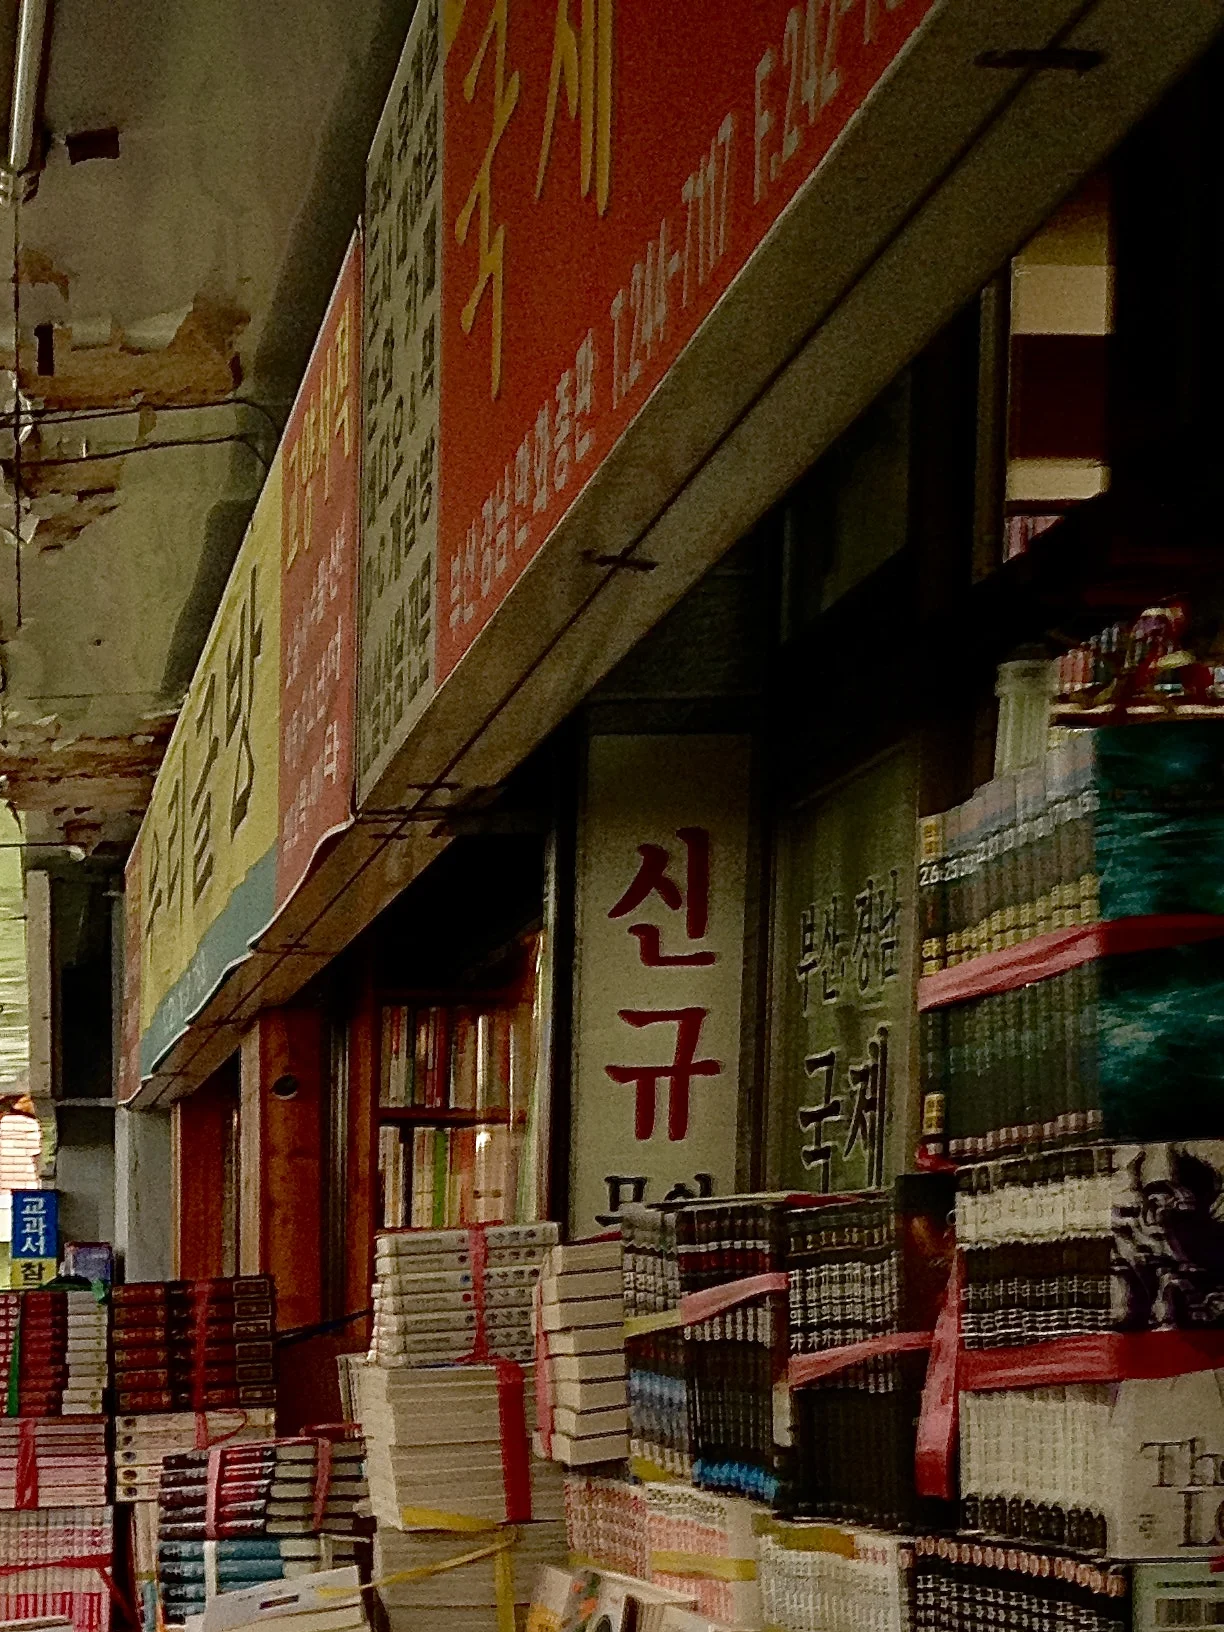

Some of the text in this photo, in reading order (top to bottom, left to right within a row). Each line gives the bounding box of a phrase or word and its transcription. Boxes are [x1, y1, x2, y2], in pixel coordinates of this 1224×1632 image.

[144, 564, 265, 937] 우리글방
[607, 826, 722, 1142] 신규
[798, 1027, 889, 1192] 국제
[20, 1197, 47, 1256] 교과서
[1139, 1437, 1224, 1487] Th
